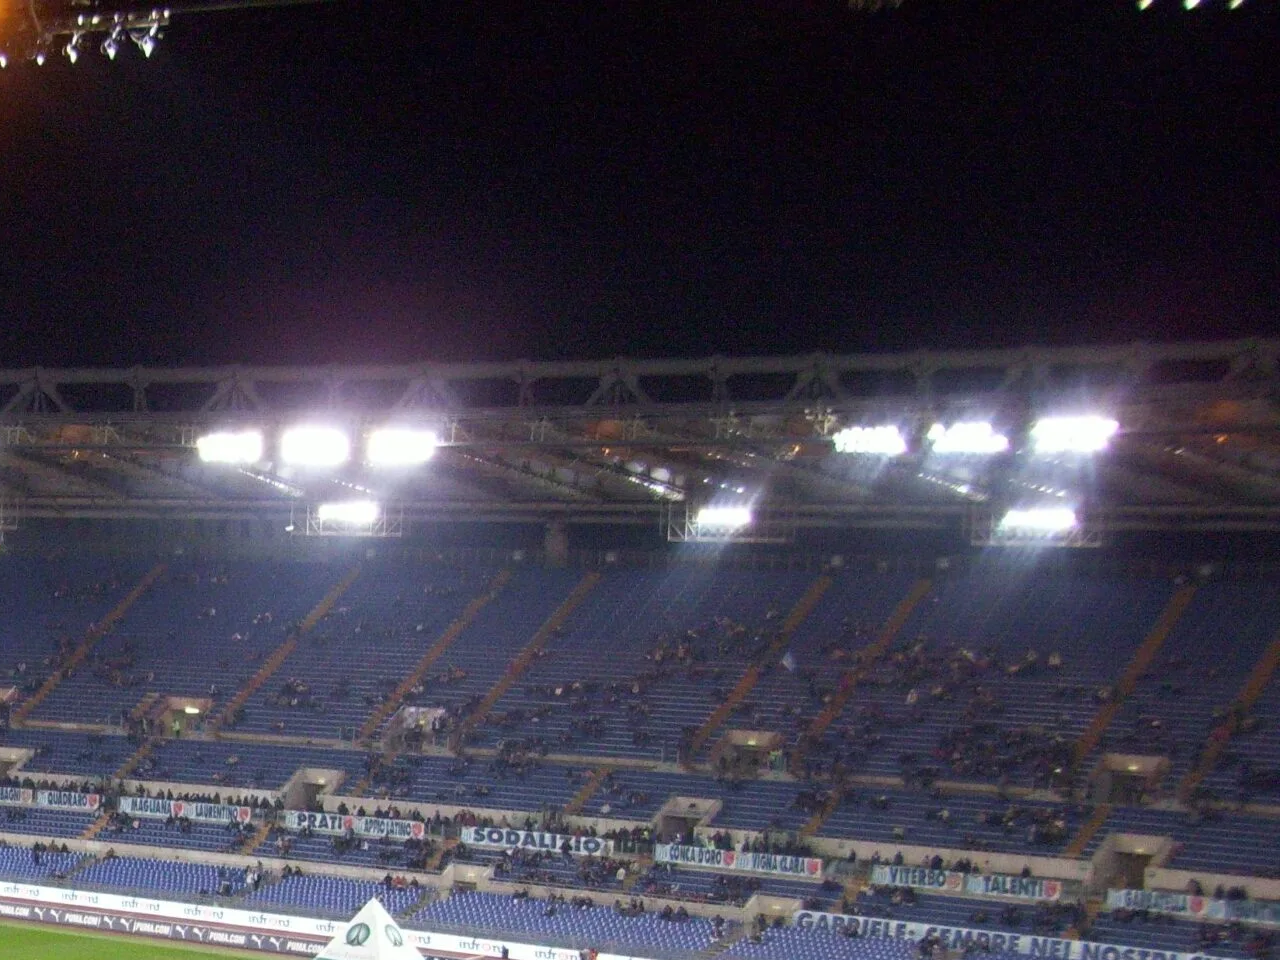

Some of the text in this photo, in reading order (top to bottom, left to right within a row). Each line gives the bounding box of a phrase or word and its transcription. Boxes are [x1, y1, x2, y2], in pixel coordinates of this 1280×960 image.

[131, 800, 172, 815] MAGLIANA
[195, 803, 237, 820] LAURENTINO
[297, 811, 343, 831] PRATI
[471, 826, 600, 853] SODALIZIO
[888, 865, 946, 887] VITERBO
[983, 876, 1043, 898] TALENTI
